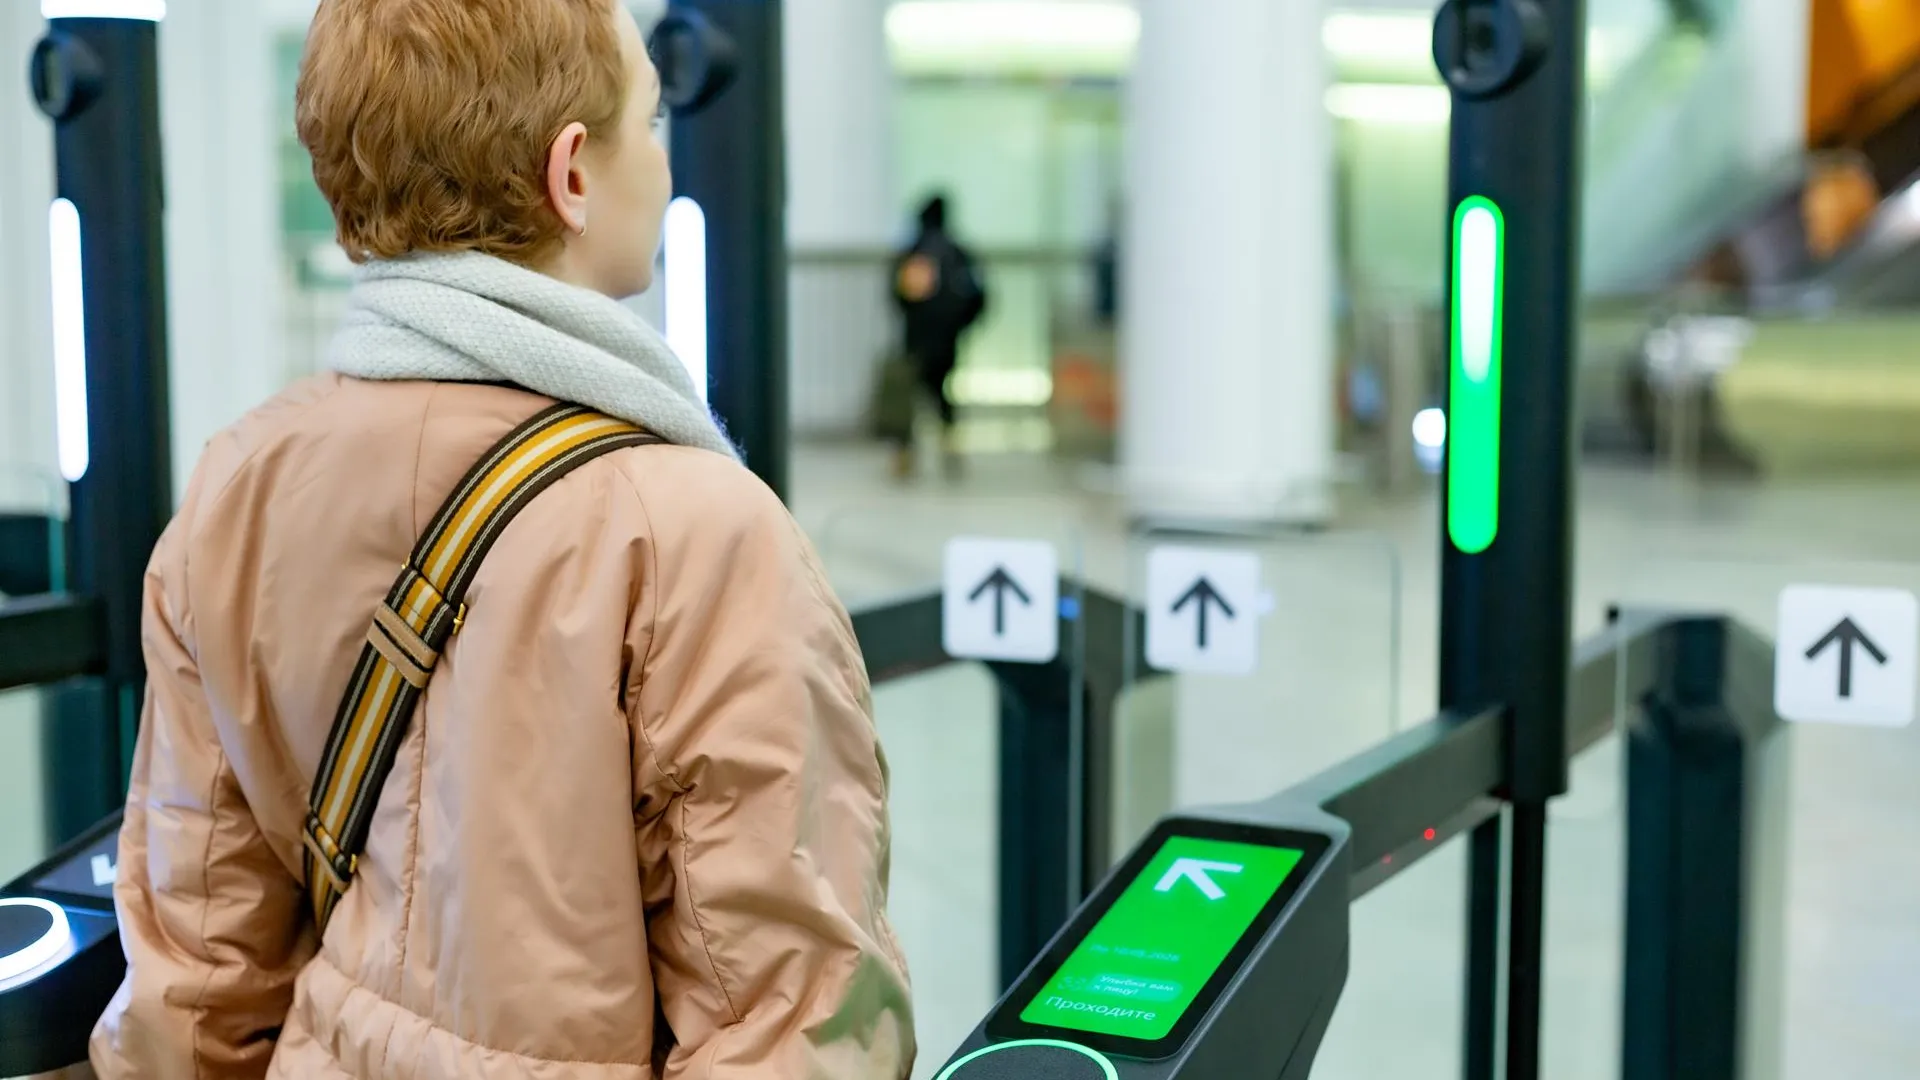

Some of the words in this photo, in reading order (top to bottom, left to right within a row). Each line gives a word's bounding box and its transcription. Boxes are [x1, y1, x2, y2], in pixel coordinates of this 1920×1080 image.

[1100, 975, 1146, 988] Улыбка
[1149, 983, 1174, 992] вам
[1104, 985, 1139, 997] лицу!
[1045, 996, 1155, 1020] Проходите
